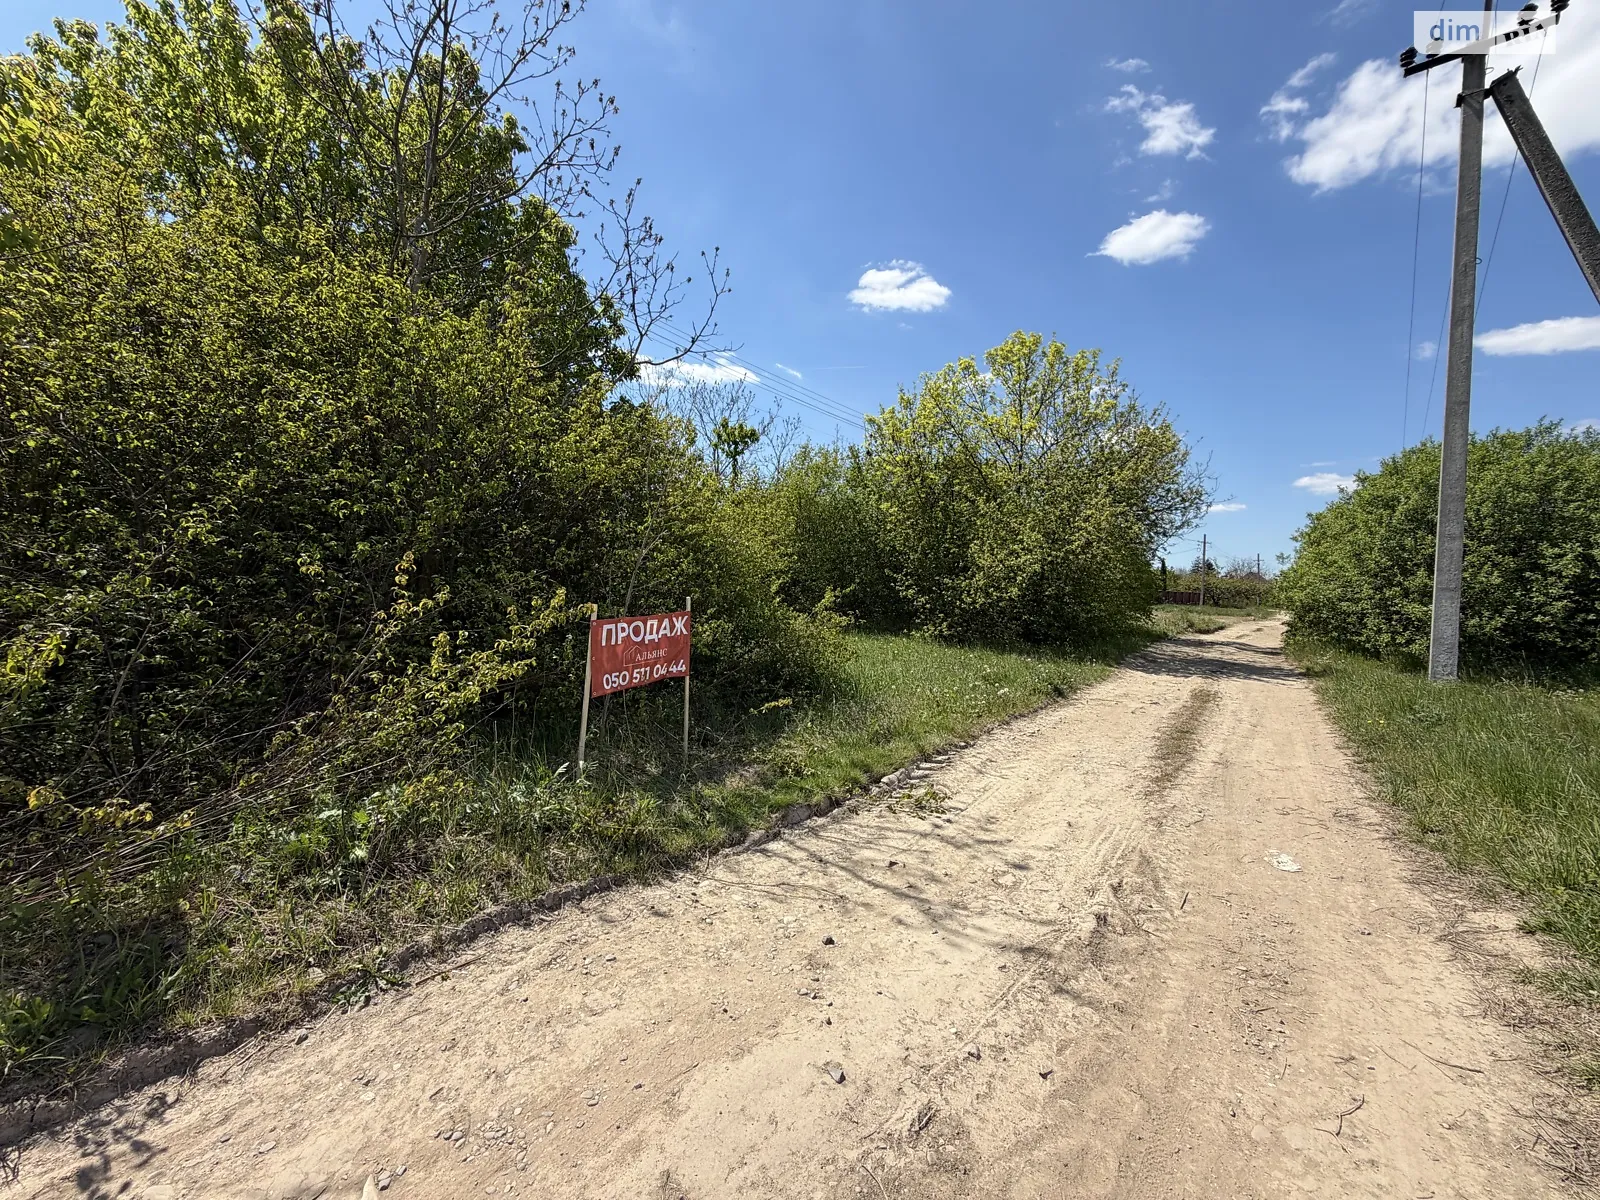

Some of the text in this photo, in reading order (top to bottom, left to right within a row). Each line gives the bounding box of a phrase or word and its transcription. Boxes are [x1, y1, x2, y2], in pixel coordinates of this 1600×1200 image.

[601, 615, 689, 647] ПРОДАЖ
[635, 648, 668, 662] АЛЬЯНС
[603, 670, 630, 690] 050
[632, 666, 650, 683] 511
